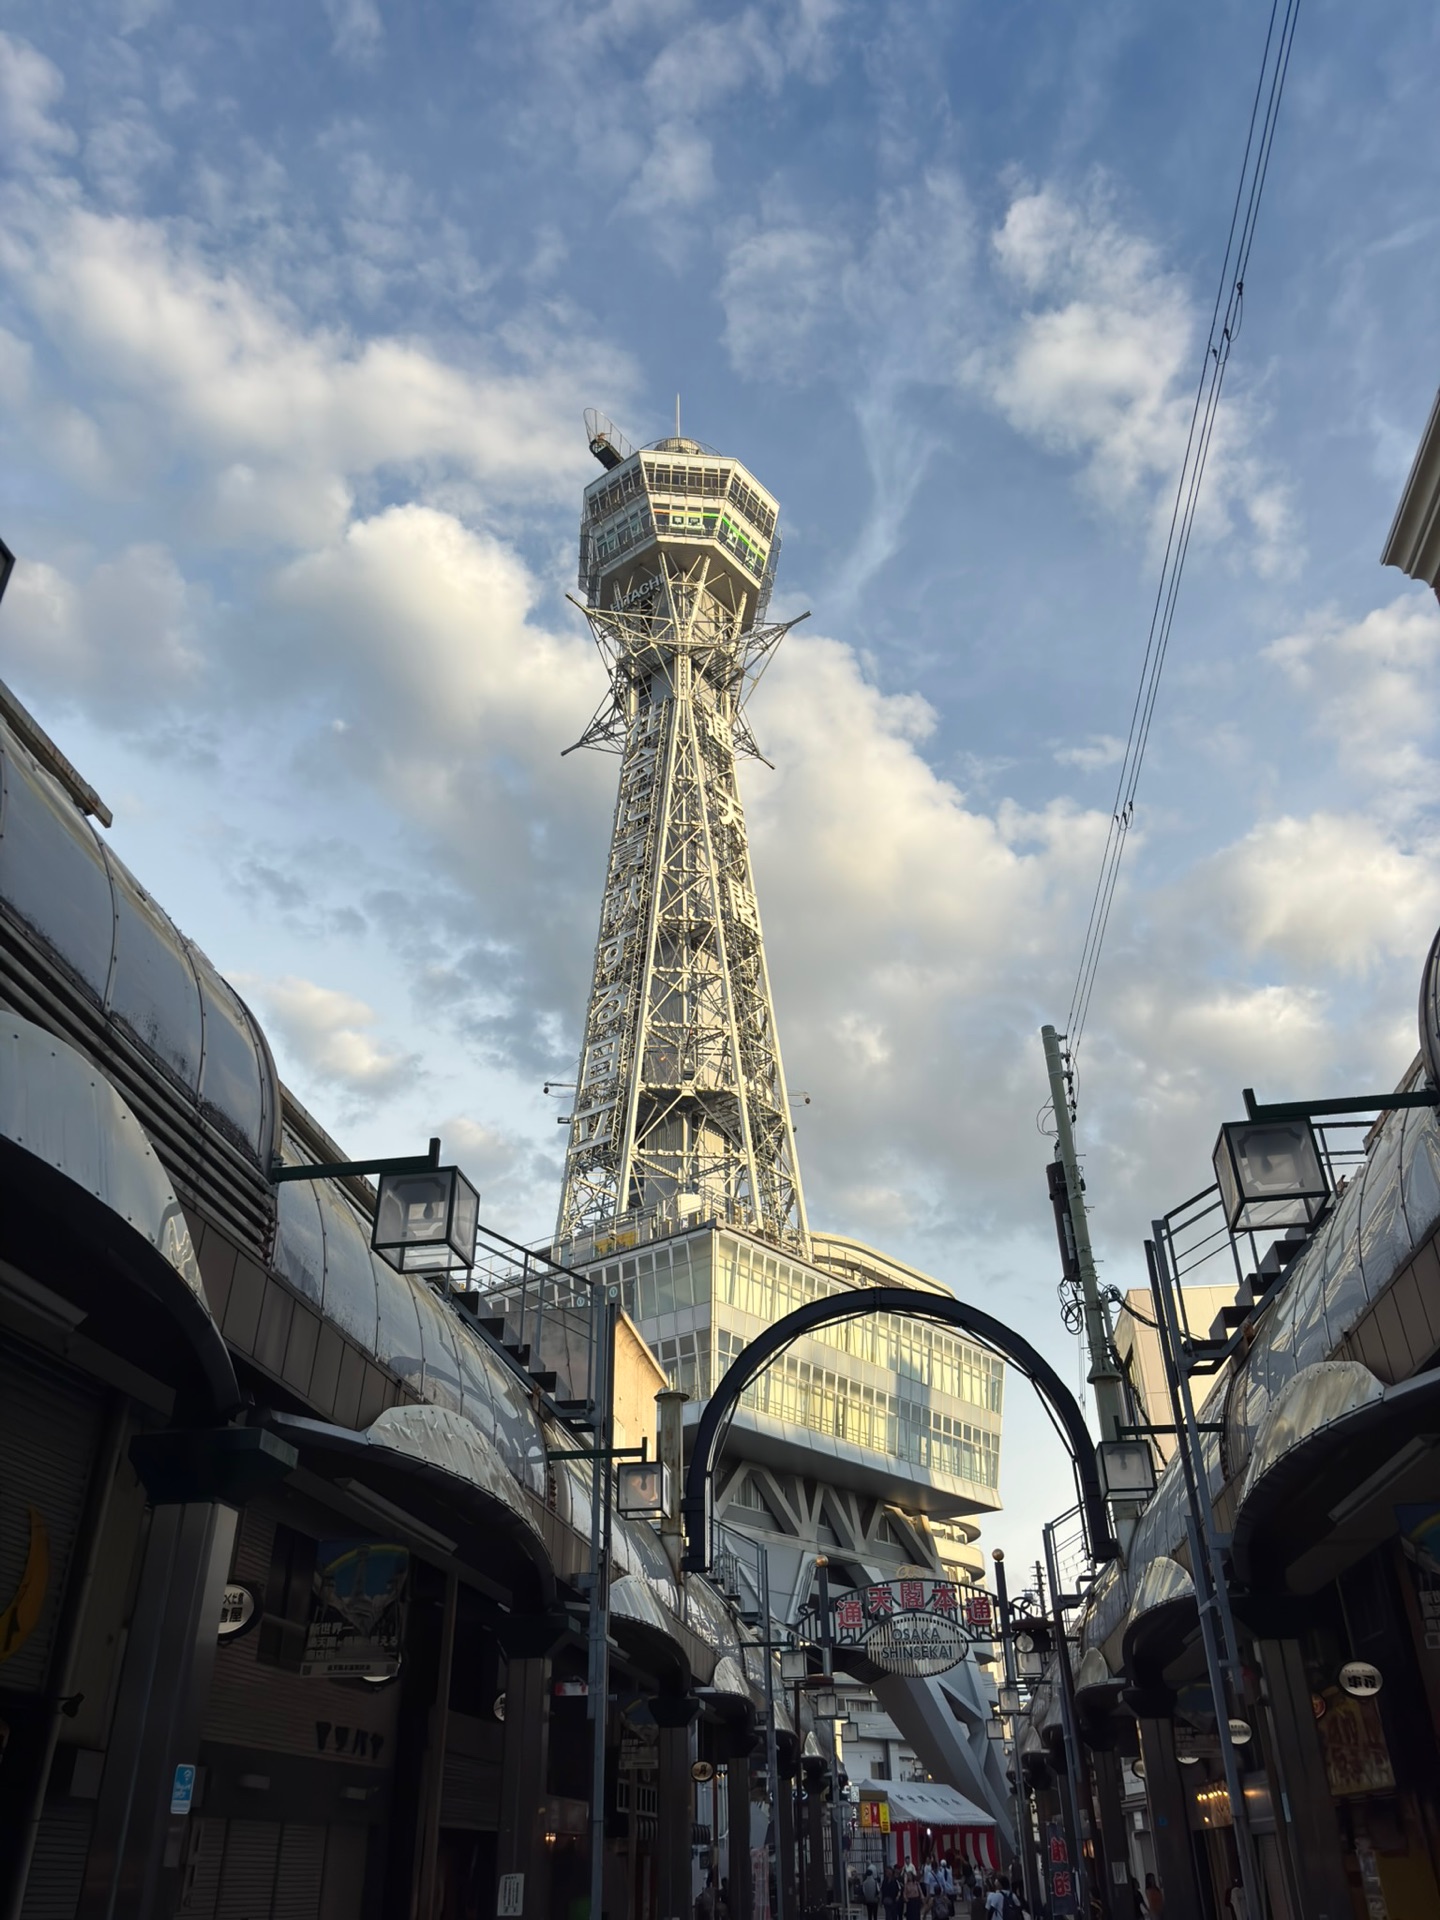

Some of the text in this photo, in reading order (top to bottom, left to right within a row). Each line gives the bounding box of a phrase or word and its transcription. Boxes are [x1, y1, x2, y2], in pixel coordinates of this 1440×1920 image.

[609, 573, 665, 612] HITACHI
[705, 710, 763, 937] 通天閣
[836, 1580, 993, 1629] 通天閣本通
[881, 1645, 953, 1659] SHINSEKAI
[892, 1627, 941, 1641] OSAKA
